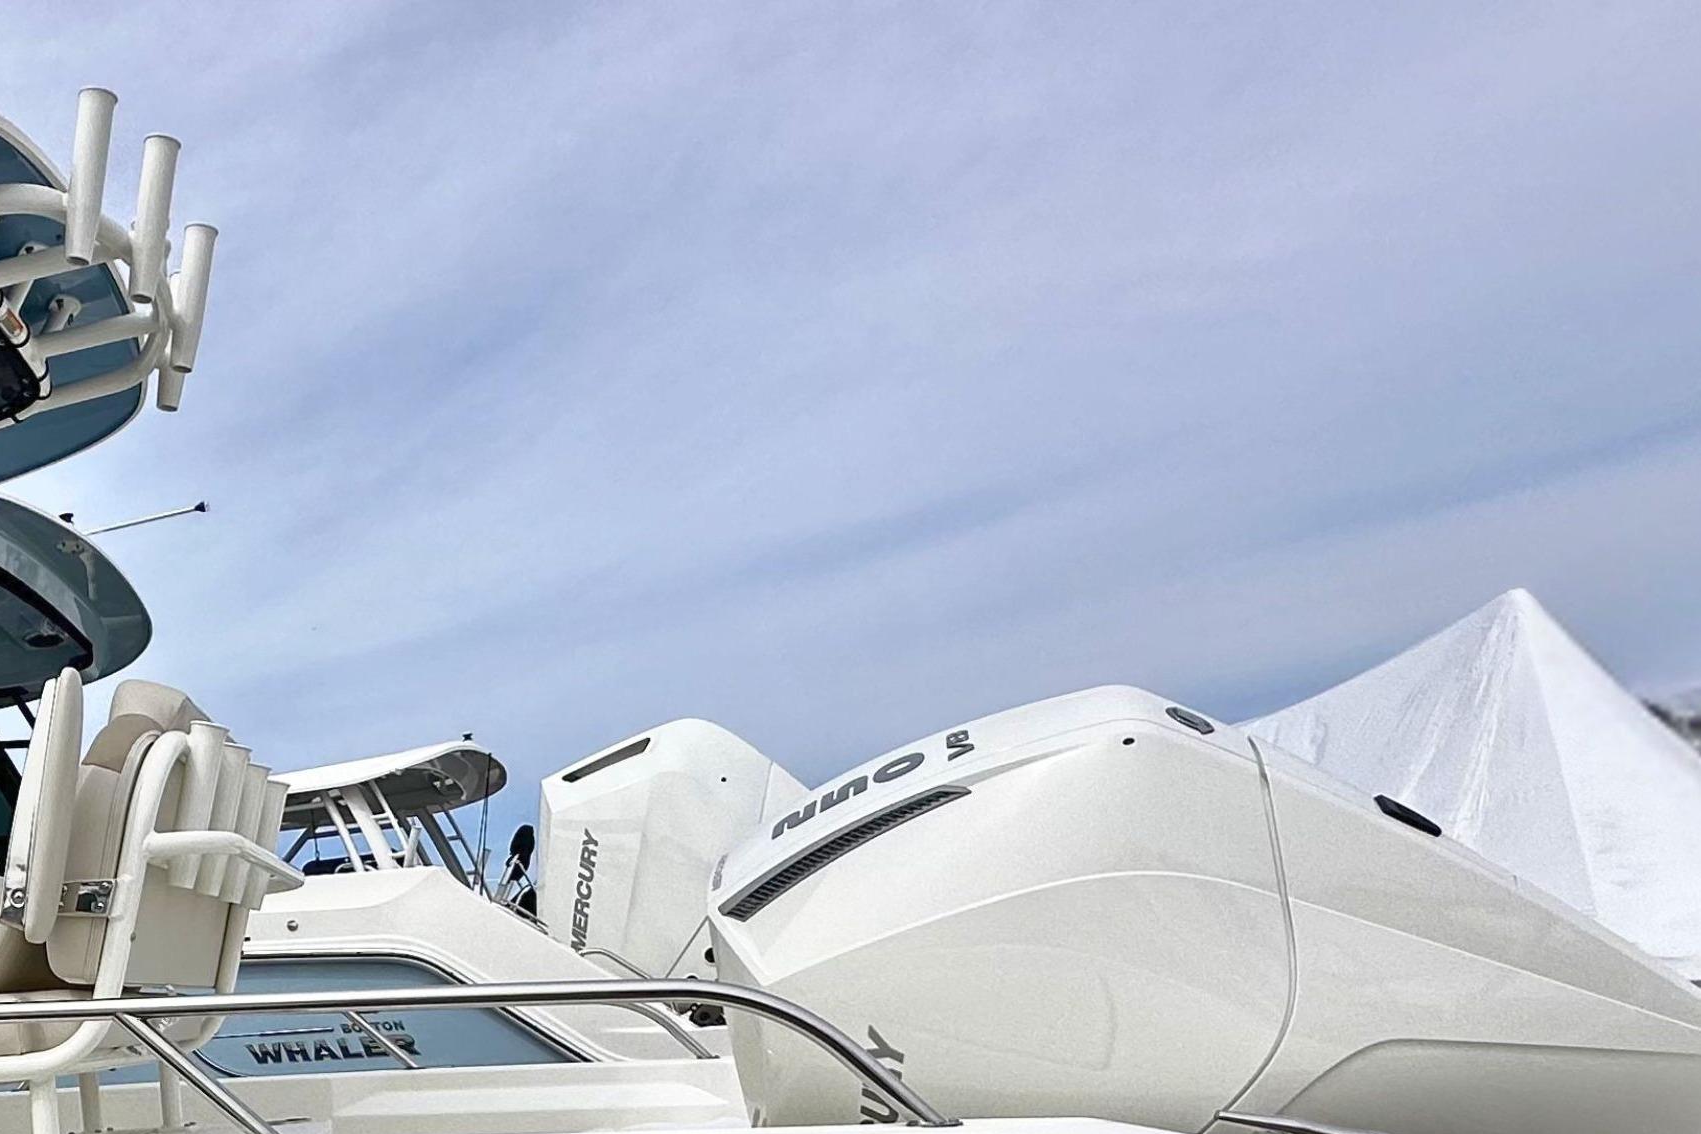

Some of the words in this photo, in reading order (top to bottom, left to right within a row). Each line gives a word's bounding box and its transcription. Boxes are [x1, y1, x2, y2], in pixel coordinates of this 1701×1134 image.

[946, 729, 975, 762] V8
[570, 828, 599, 954] MERCURY
[340, 1020, 406, 1034] BOTON
